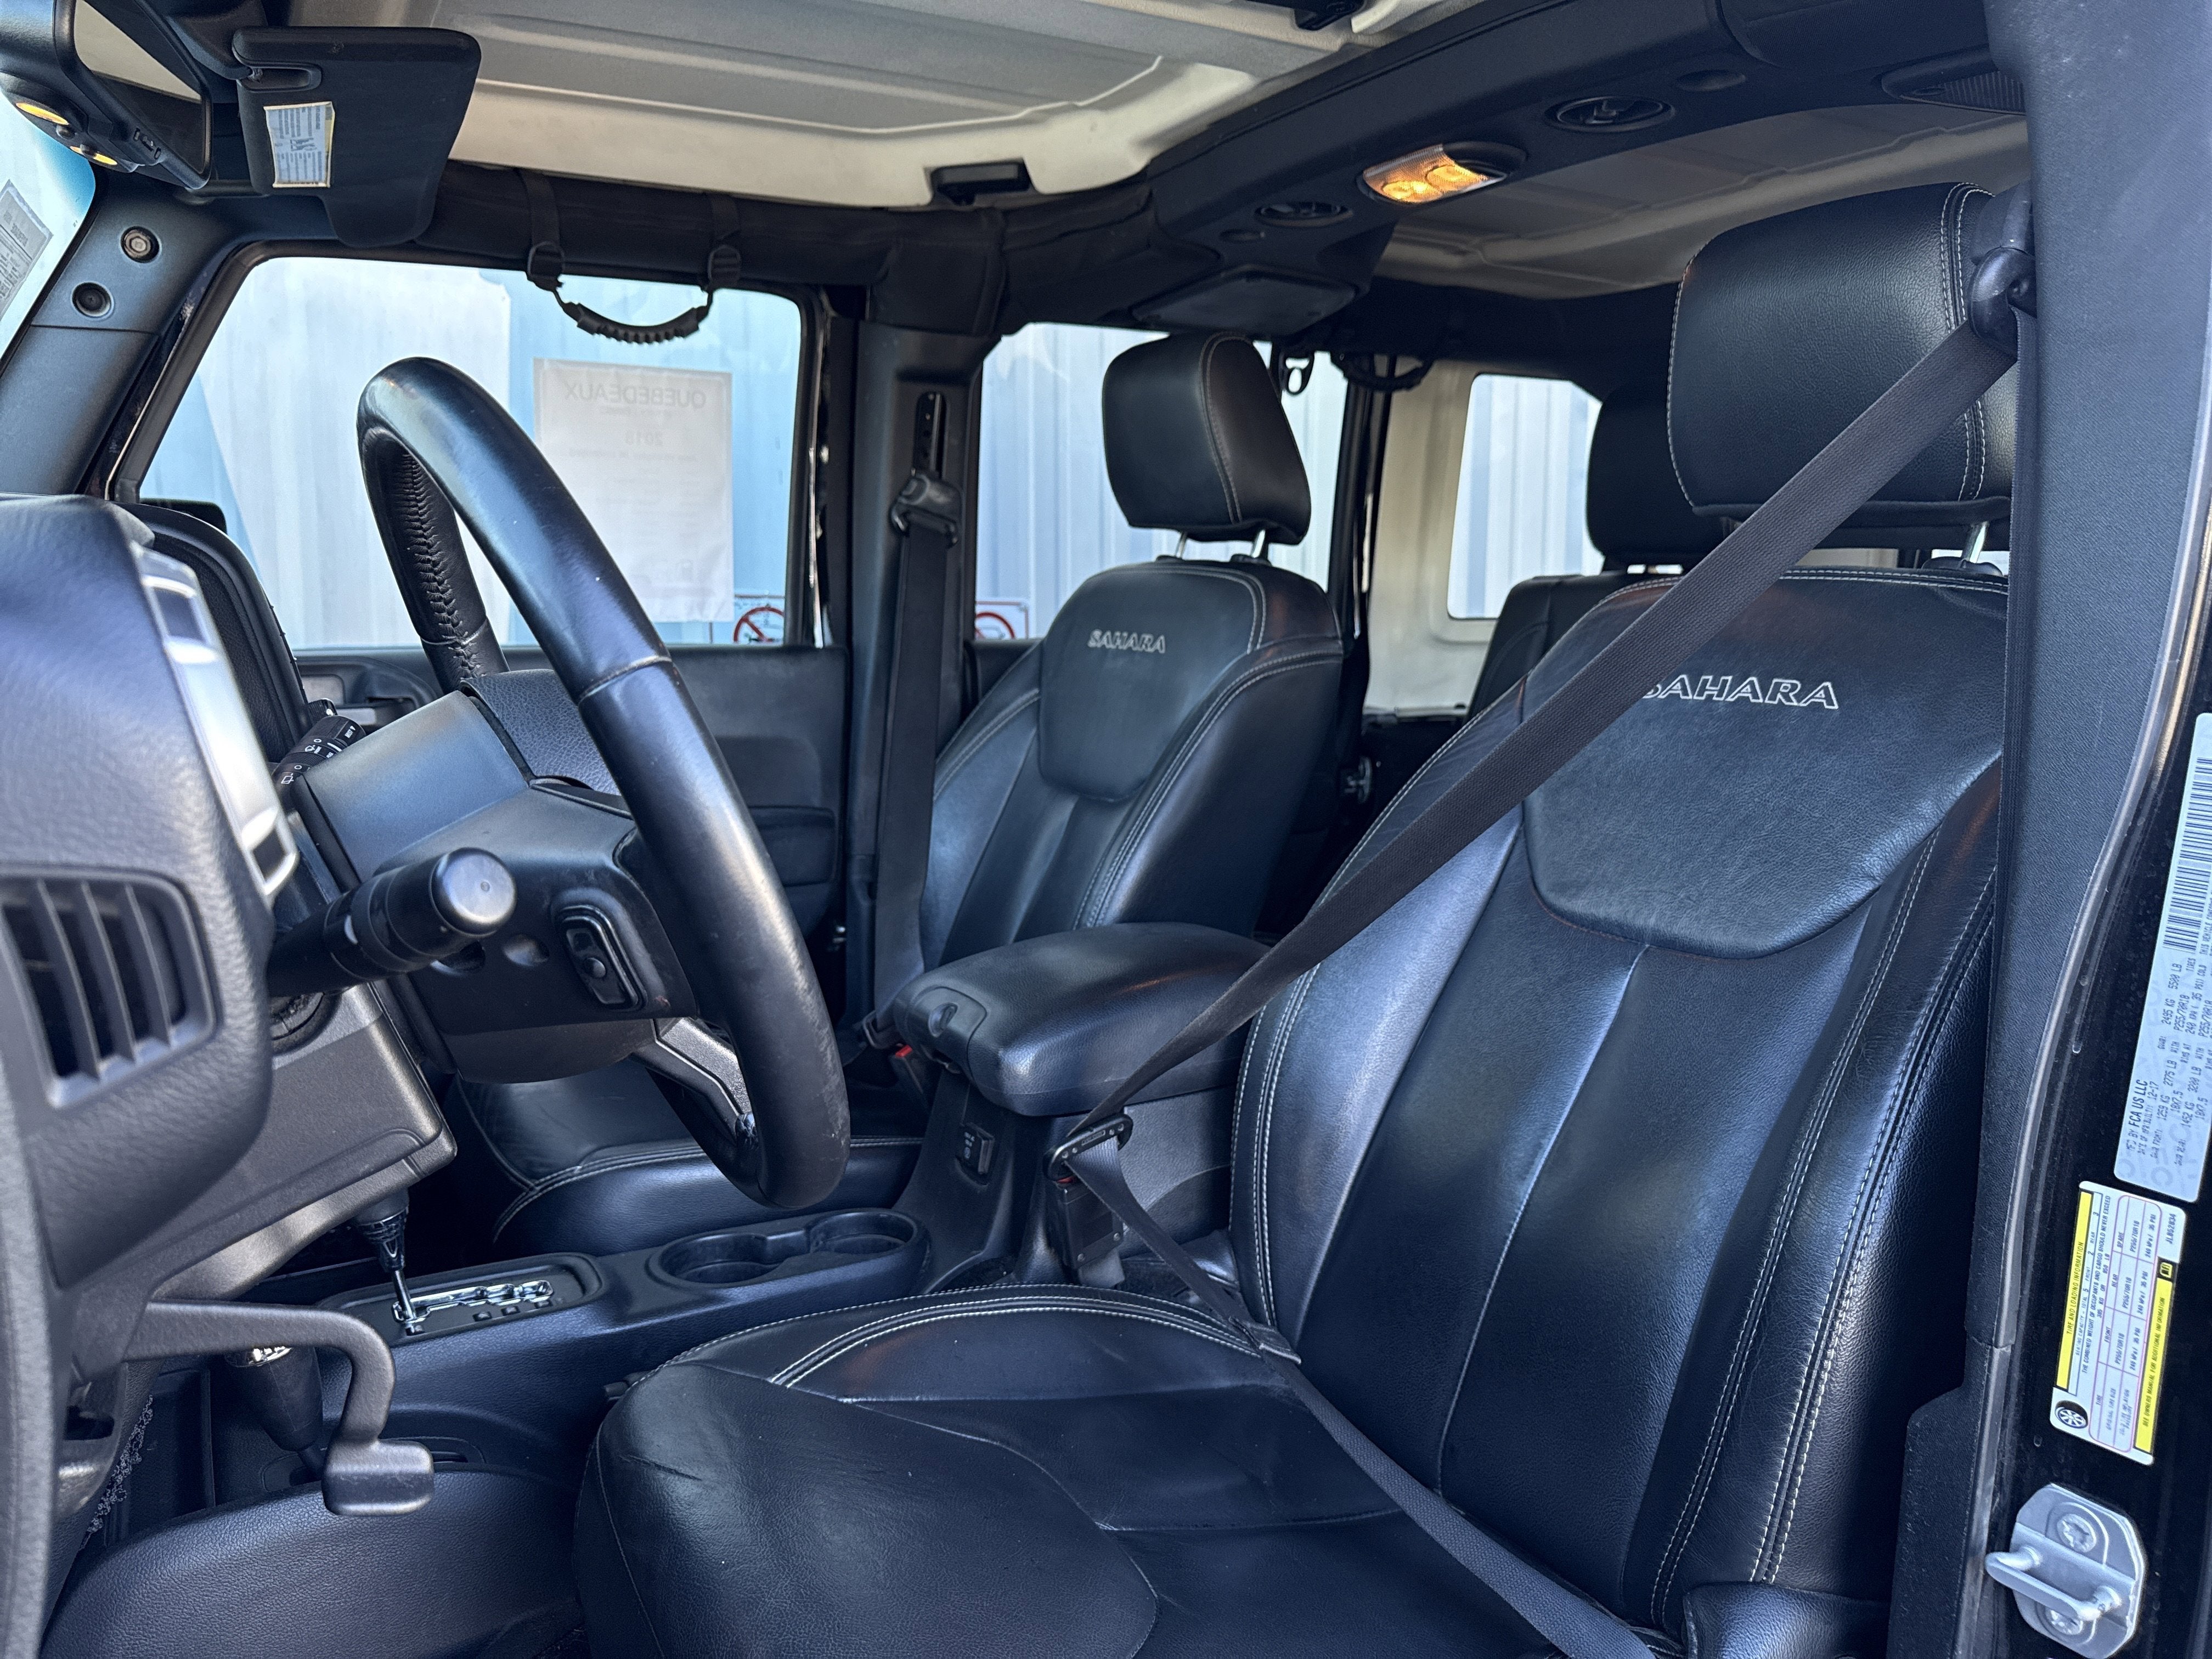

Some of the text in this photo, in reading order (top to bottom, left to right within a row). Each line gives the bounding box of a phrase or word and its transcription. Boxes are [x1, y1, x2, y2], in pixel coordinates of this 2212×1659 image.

[1087, 629, 1166, 654] SAHARA
[2199, 943, 2209, 955] THIS
[2171, 963, 2181, 972] LB
[2186, 957, 2196, 972] TIRES
[2168, 973, 2180, 990] 5500
[2164, 998, 2175, 1007] KG
[2162, 1008, 2173, 1024] 2495
[2174, 994, 2189, 1031] P255/70R18
[2170, 1090, 2183, 1113] 18X7.5
[2185, 1021, 2196, 1034] 240
[2191, 992, 2202, 1001] 35
[2197, 964, 2206, 977] COLD
[2166, 1059, 2176, 1069] LB
[2190, 1066, 2201, 1075] LB
[2163, 1070, 2175, 1086] 2775
[2187, 1076, 2199, 1093] 3200
[2134, 1079, 2147, 1096] LLC
[2147, 1081, 2159, 1100] 12-17
[2131, 1096, 2144, 1109] US
[2159, 1094, 2170, 1103] KG
[2183, 1101, 2194, 1110] KG
[2156, 1104, 2168, 1120] 1259
[2194, 1096, 2208, 1120] 18X7.5
[2128, 1109, 2142, 1127] FCA
[2180, 1111, 2192, 1127] 1452
[2129, 1128, 2138, 1137] BY
[2074, 1242, 2083, 1280] INFORMATION
[2155, 1297, 2164, 1331] INFORMATION
